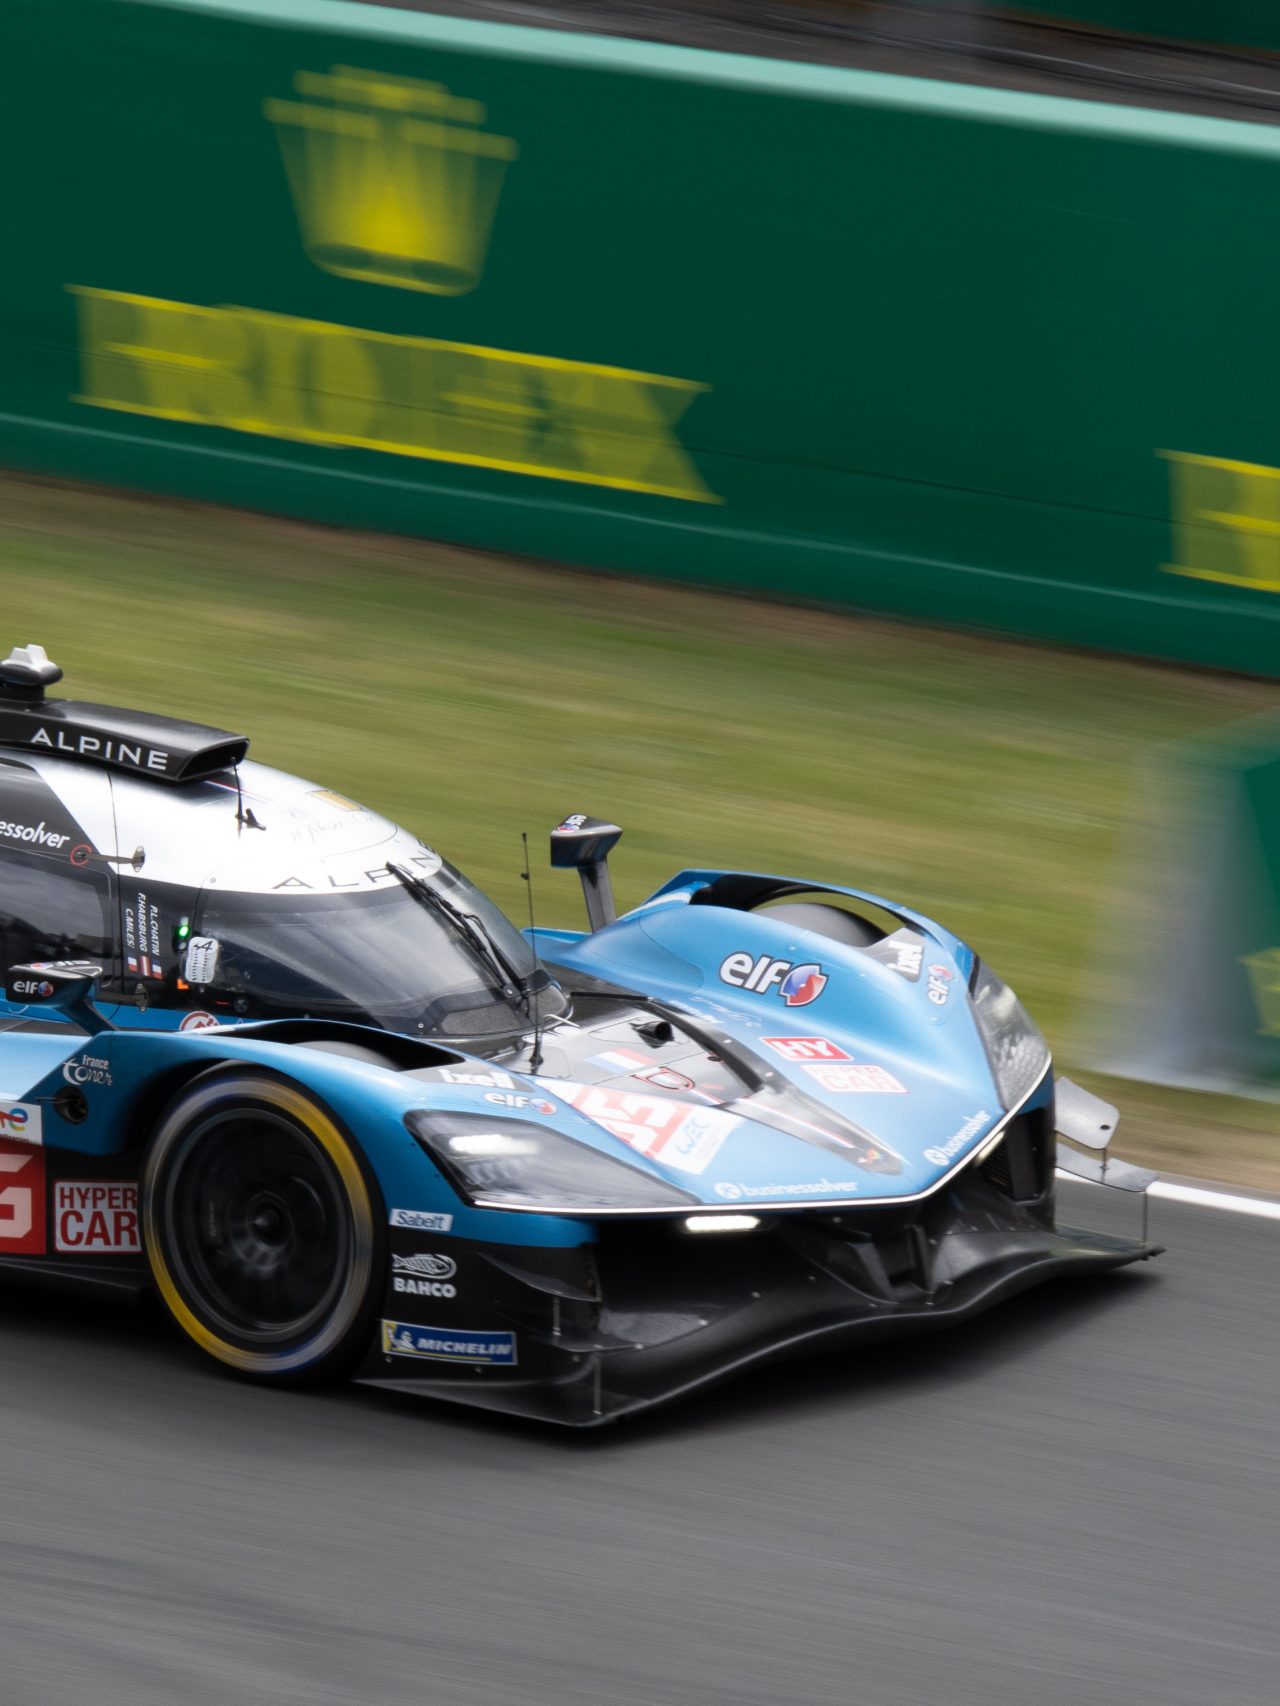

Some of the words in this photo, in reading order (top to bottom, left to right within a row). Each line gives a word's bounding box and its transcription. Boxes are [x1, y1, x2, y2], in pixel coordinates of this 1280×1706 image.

[31, 728, 169, 771] ALPINE
[138, 892, 147, 952] F.HABSBURG
[721, 953, 790, 992] elf
[13, 981, 38, 994] elf
[927, 976, 949, 1005] elf
[769, 1039, 837, 1057] HY
[484, 1093, 529, 1108] elf
[674, 1116, 711, 1155] WEC
[941, 1110, 992, 1158] businessolver
[59, 1186, 138, 1210] HYPER
[740, 1178, 858, 1197] businessolver
[60, 1211, 138, 1247] CAR
[396, 1210, 445, 1229] Sabelt
[393, 1277, 457, 1298] BAHCO
[417, 1337, 513, 1355] MICHELIN
